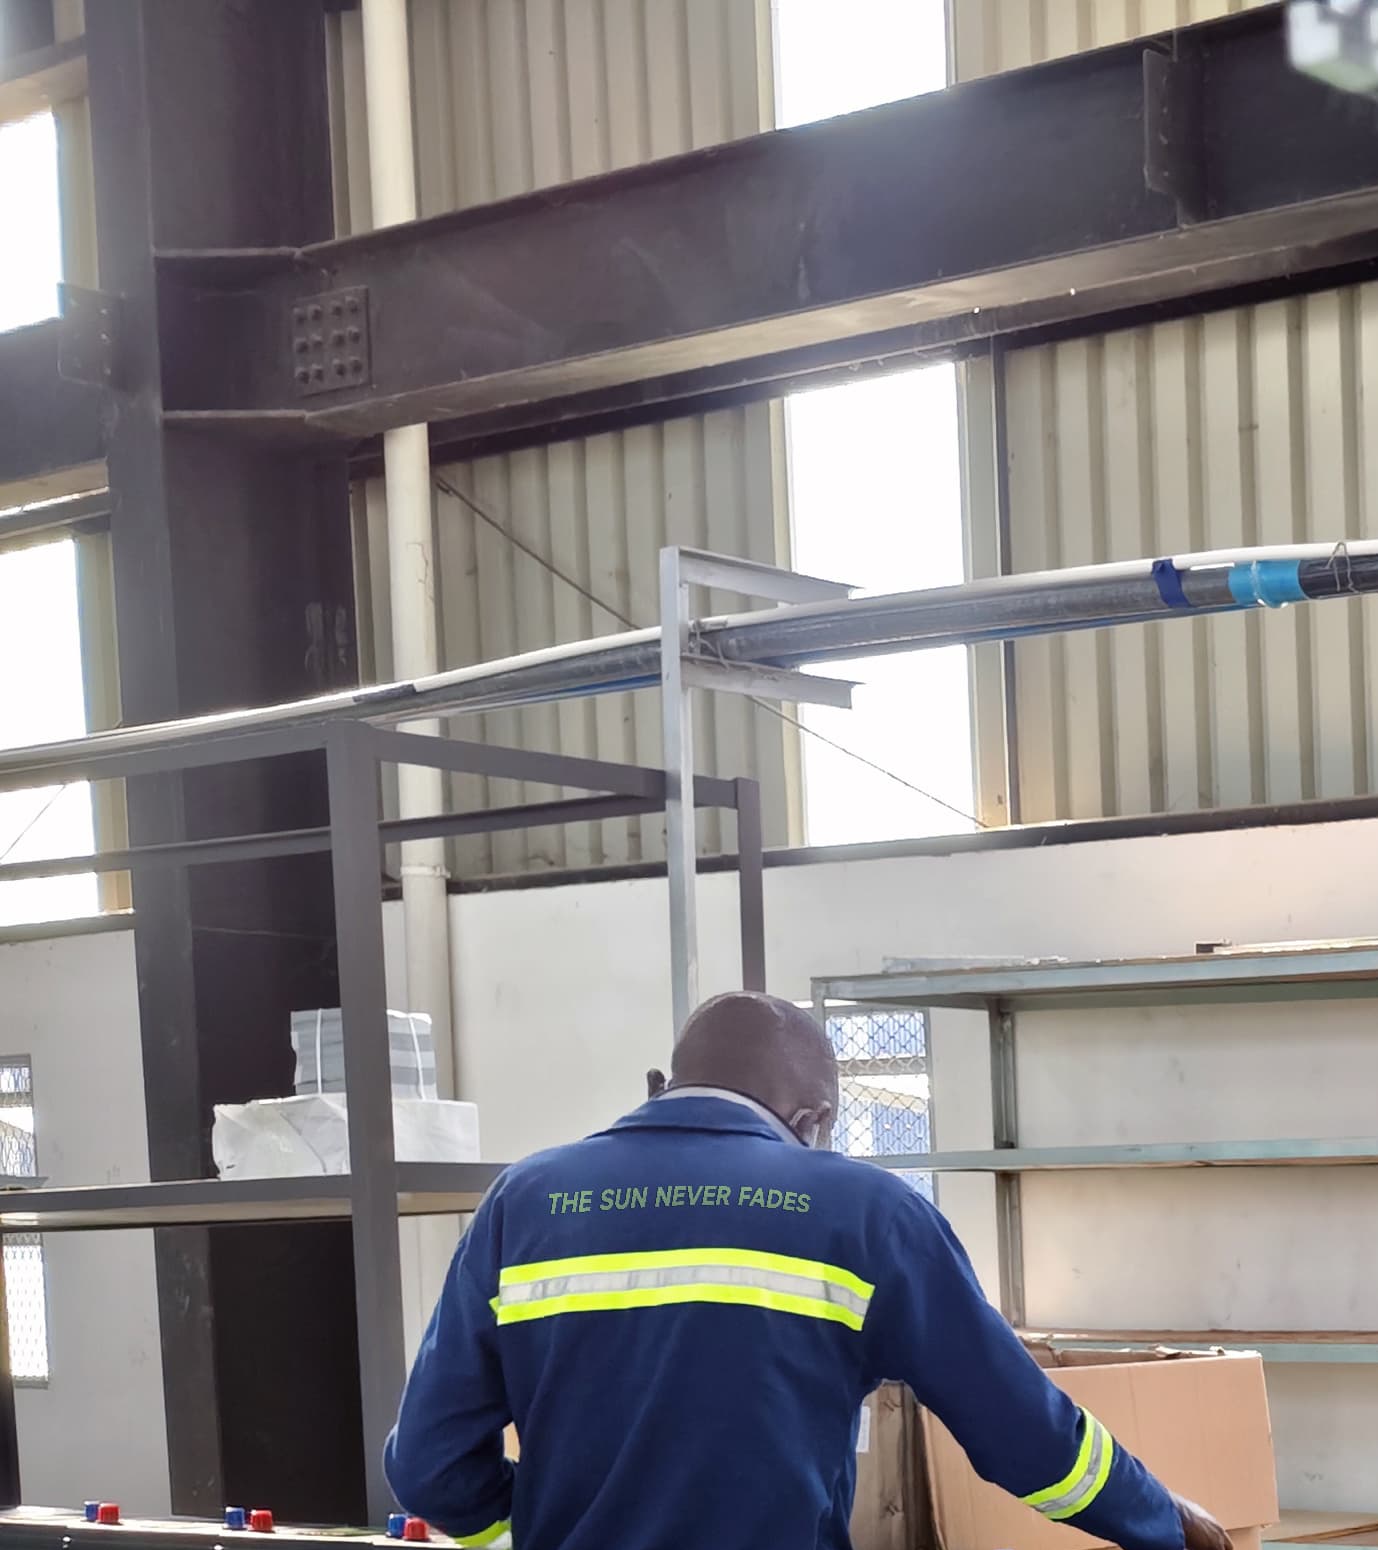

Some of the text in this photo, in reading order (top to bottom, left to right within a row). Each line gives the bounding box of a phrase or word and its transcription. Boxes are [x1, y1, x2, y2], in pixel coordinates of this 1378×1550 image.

[549, 1185, 812, 1215] THE SUN NEVER FADES
